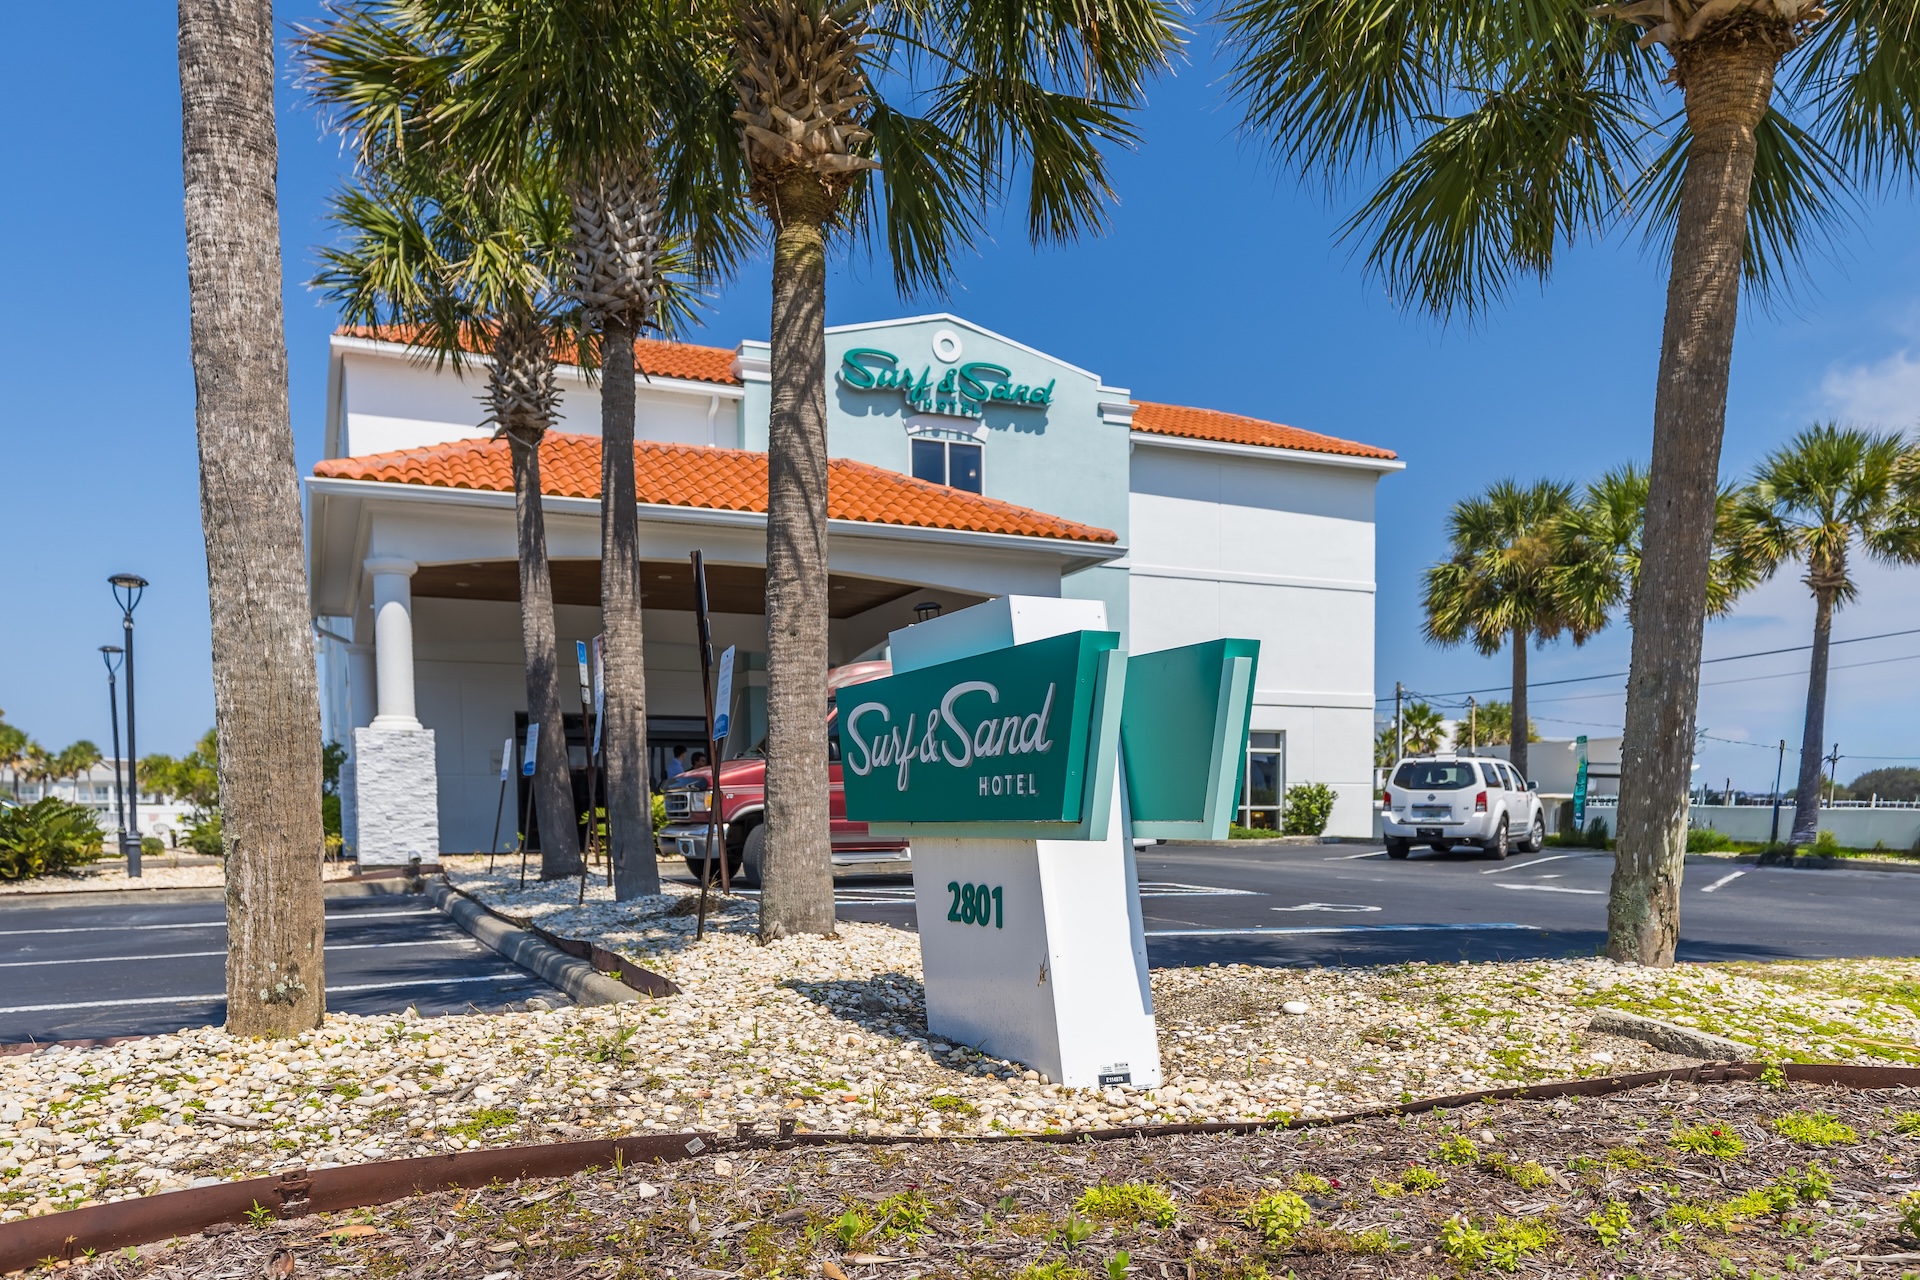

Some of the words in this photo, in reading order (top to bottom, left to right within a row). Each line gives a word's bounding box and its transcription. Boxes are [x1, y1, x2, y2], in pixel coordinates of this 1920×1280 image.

[843, 348, 934, 403] Surf
[937, 368, 958, 393] &
[960, 362, 1056, 405] Sand
[923, 398, 981, 415] HOTEL
[847, 702, 919, 792] Surf
[919, 708, 941, 764] &
[940, 680, 1056, 769] Sand
[979, 773, 1039, 797] HOTEL
[947, 881, 1003, 930] 2801
